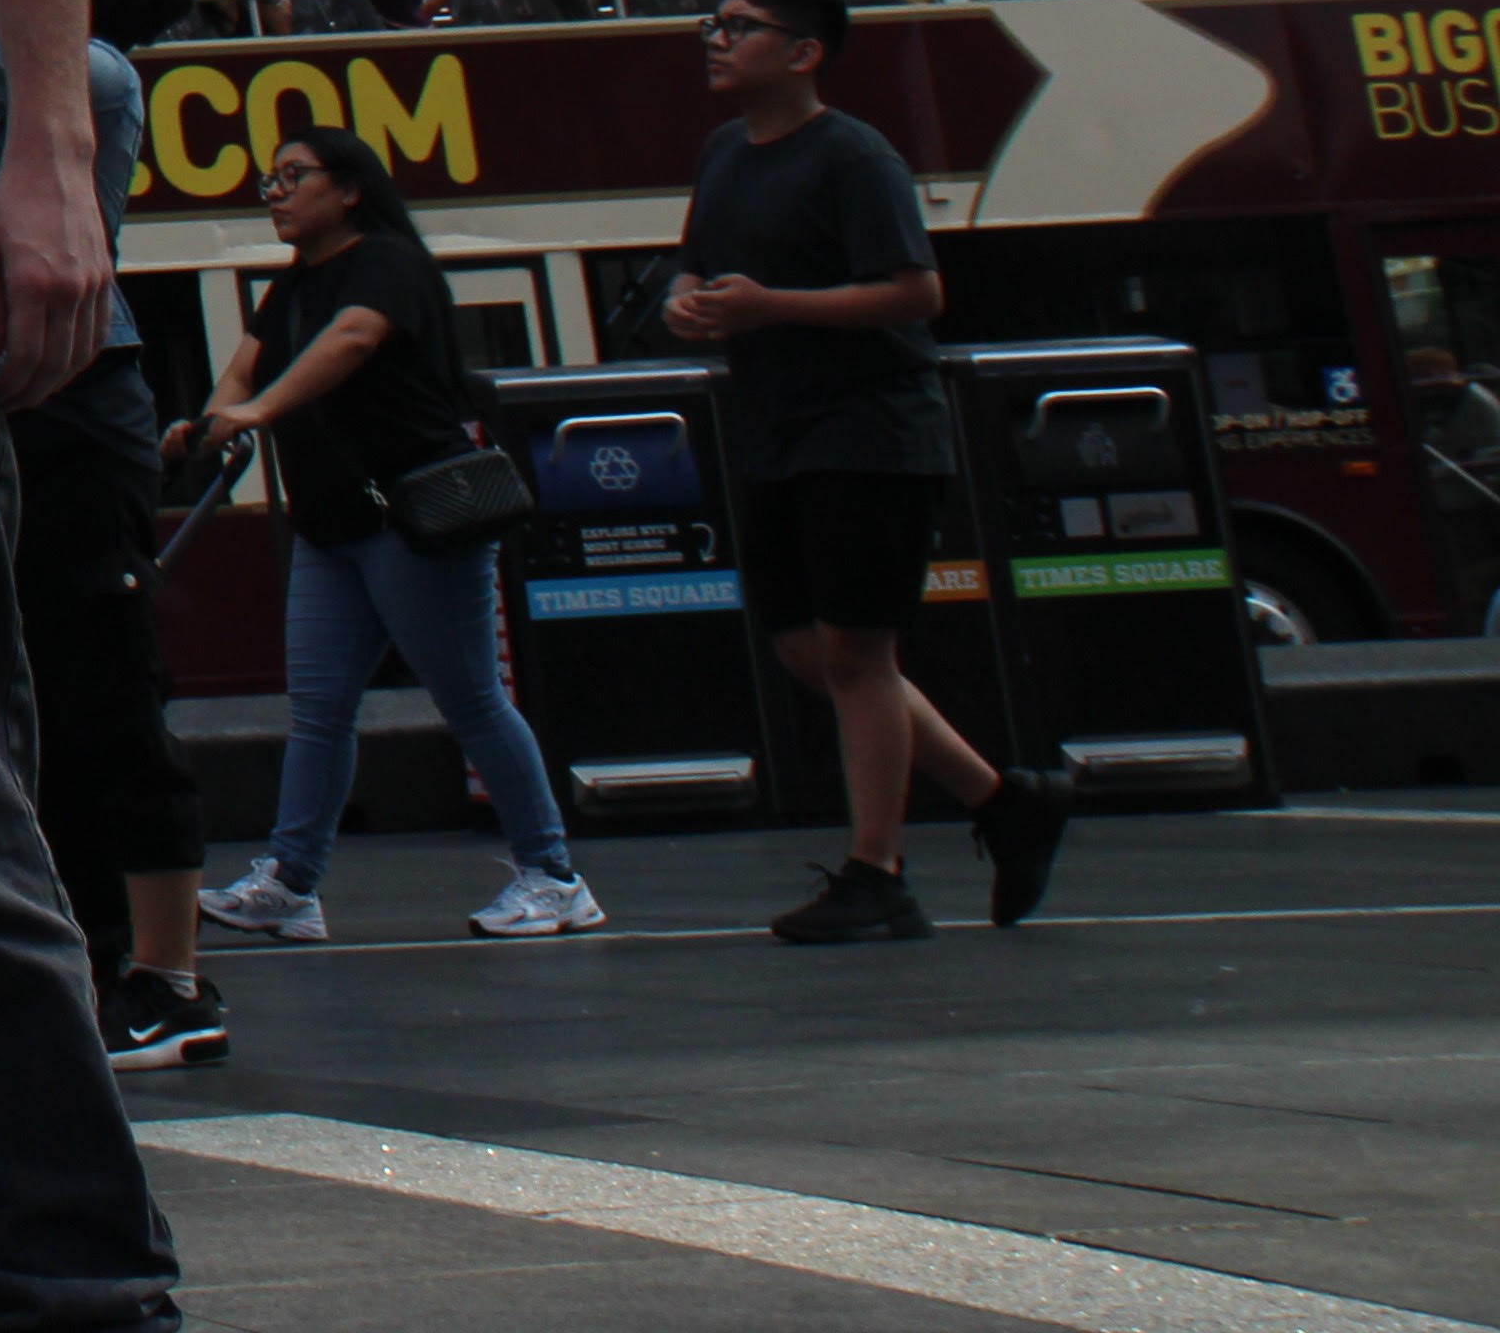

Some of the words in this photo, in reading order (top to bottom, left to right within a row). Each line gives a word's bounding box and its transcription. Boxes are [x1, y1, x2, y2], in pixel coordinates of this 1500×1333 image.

[1351, 9, 1486, 77] BIG
[1365, 78, 1500, 139] BUS
[1016, 564, 1109, 589] TIMES
[1113, 558, 1226, 584] SQUARE
[534, 588, 623, 613] TIMES
[628, 582, 736, 609] SQUARE
